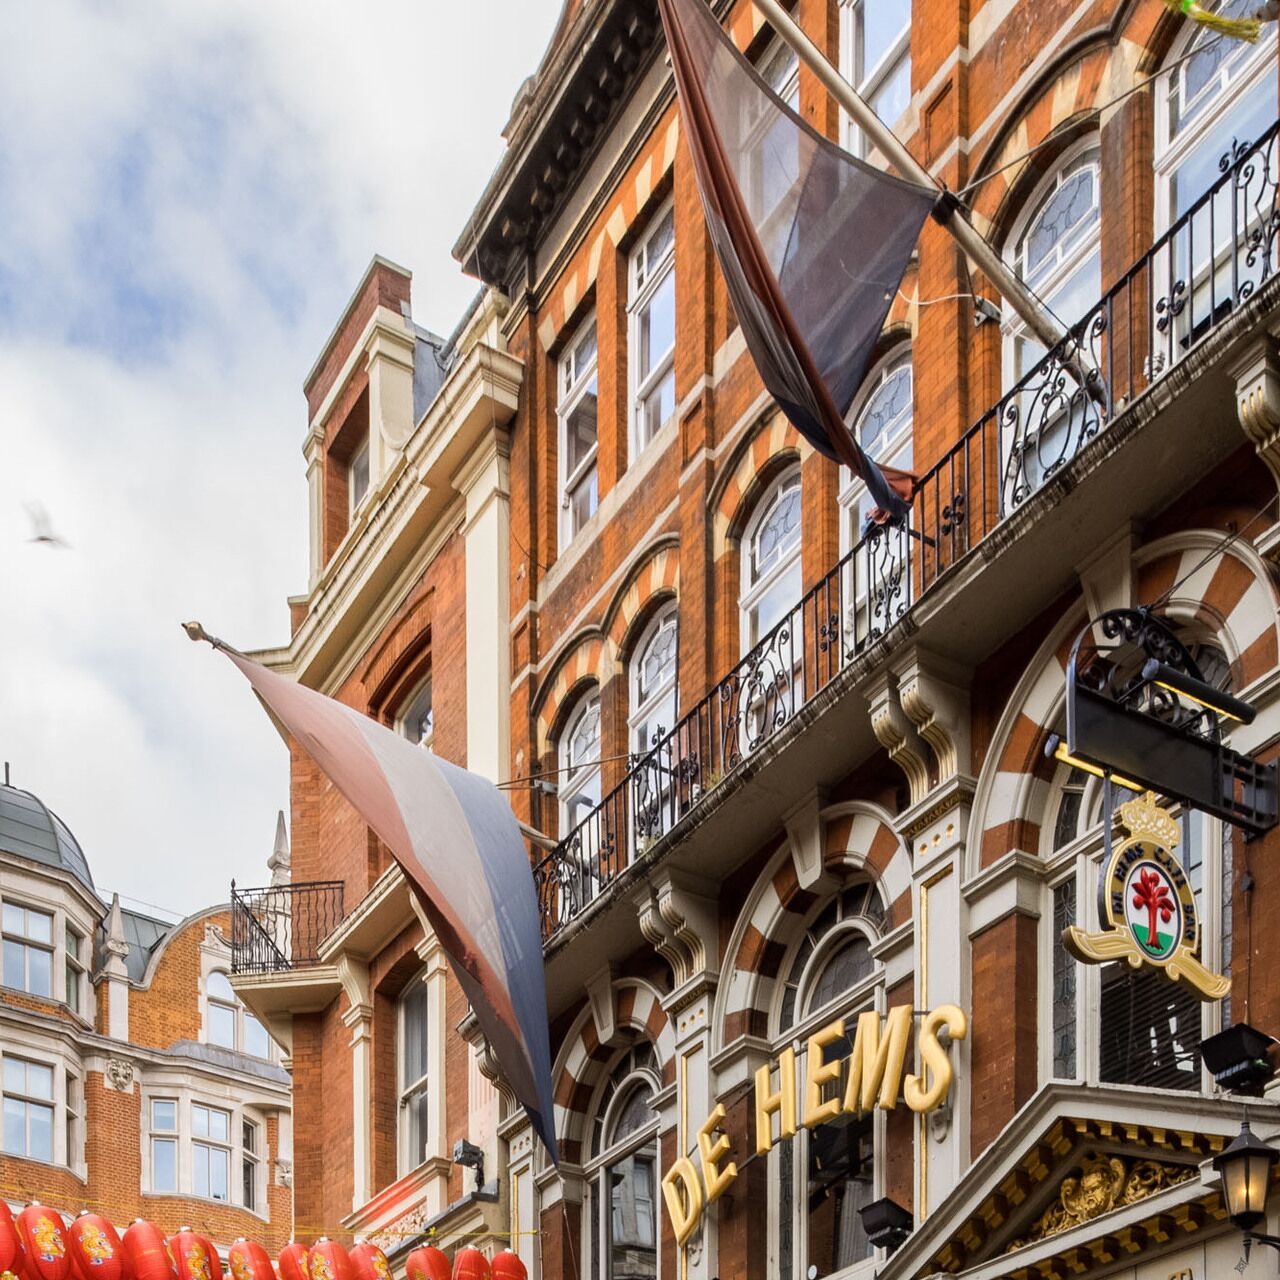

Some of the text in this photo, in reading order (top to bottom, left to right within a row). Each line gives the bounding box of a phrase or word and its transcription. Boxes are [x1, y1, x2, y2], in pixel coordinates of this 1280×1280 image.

[1183, 904, 1196, 940] BAR
[660, 1003, 968, 1247] DE HEMS
